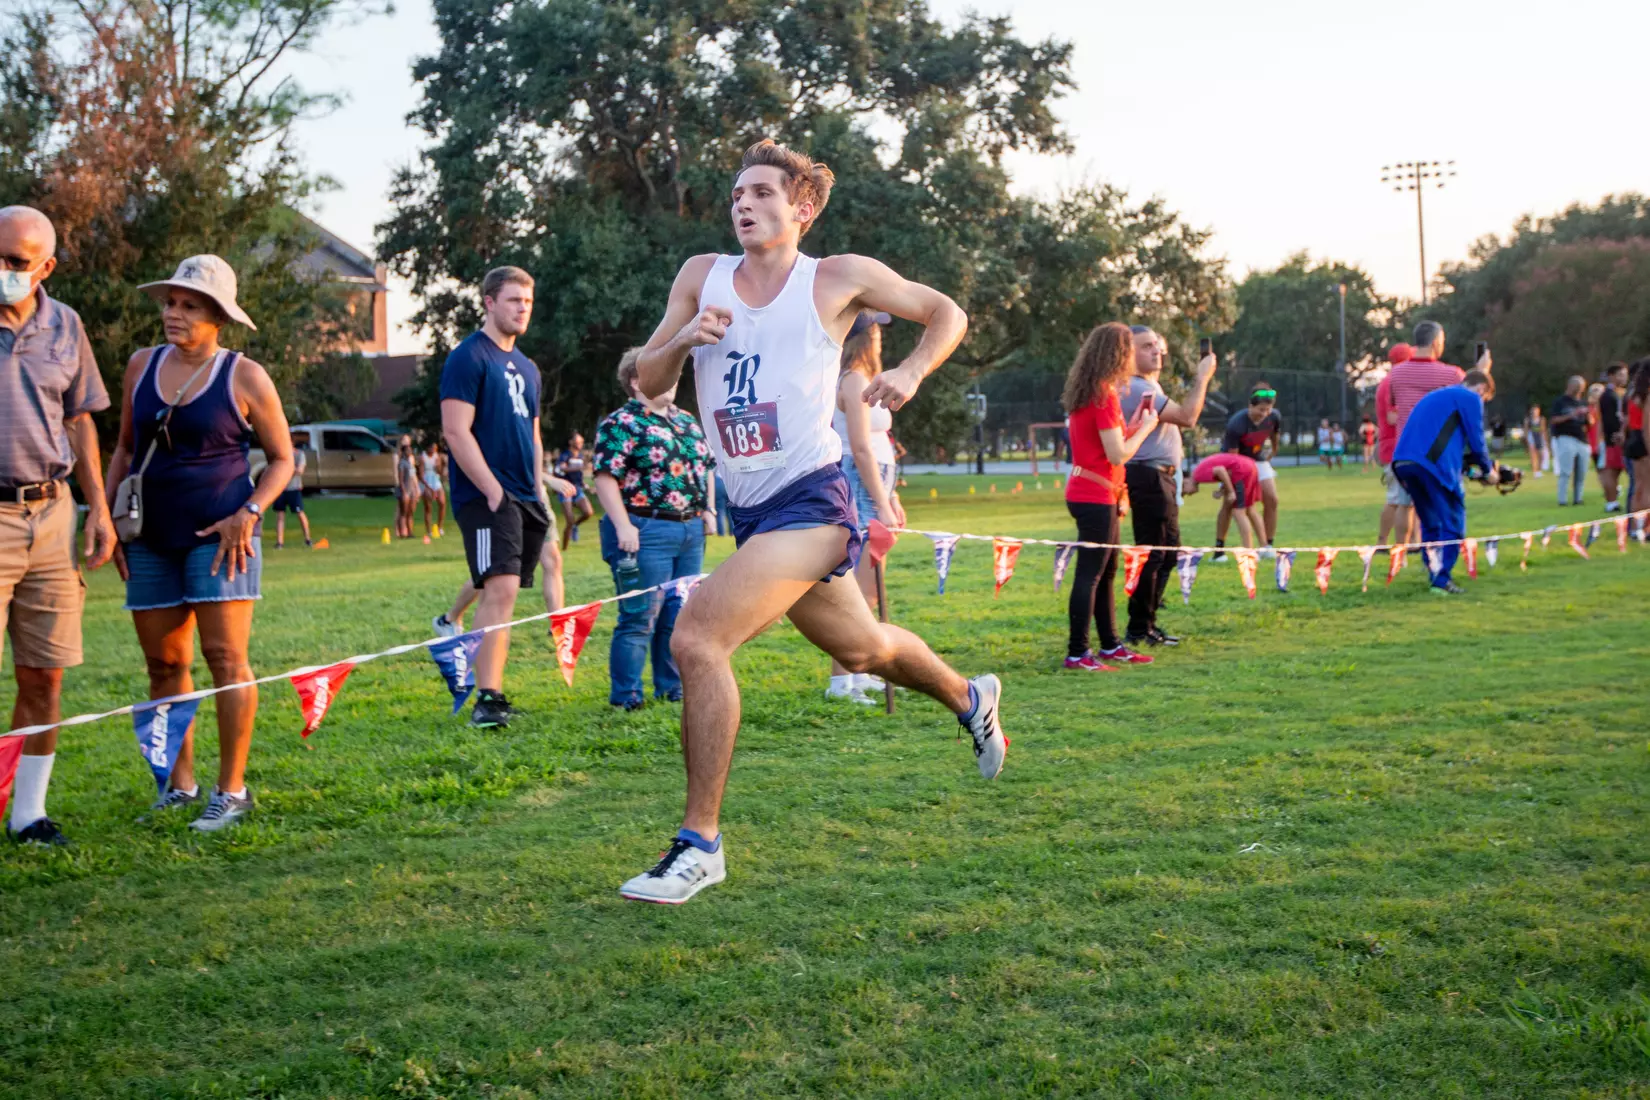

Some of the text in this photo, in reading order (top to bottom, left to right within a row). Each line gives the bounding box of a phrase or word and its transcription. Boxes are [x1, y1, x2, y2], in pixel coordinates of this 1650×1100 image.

[504, 371, 529, 419] R
[723, 350, 761, 407] R
[725, 421, 764, 455] 183
